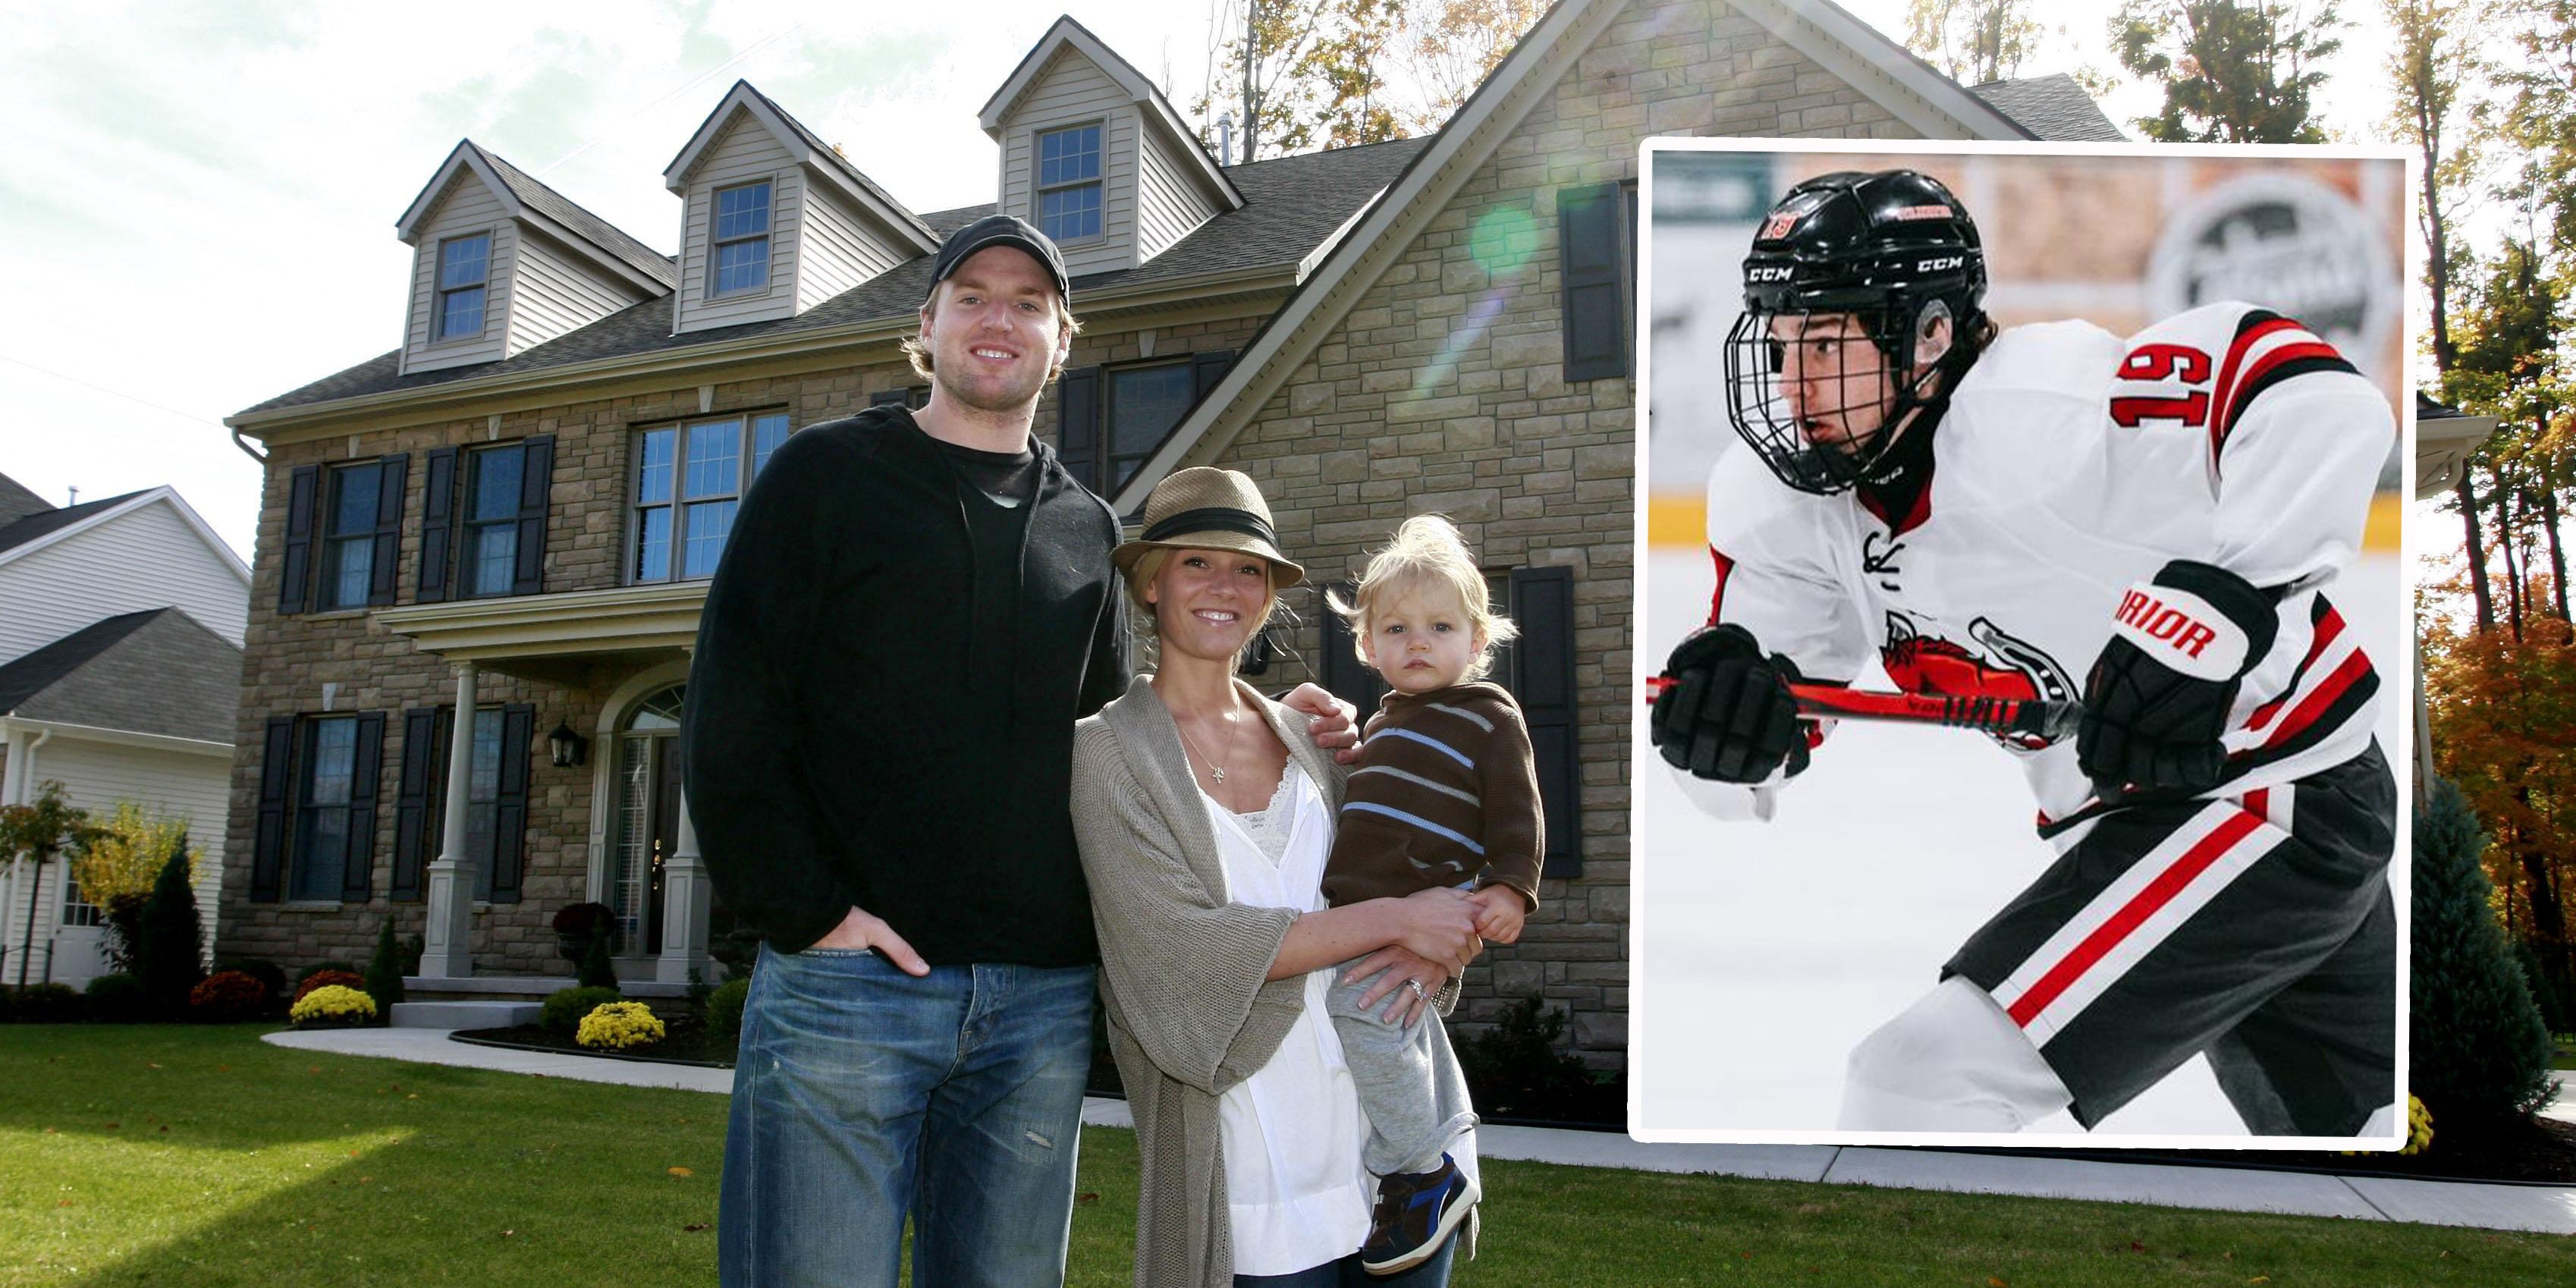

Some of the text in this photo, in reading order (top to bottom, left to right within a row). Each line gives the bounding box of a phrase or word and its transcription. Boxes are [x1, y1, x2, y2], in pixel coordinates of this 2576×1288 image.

[1918, 256, 1963, 272] CCM
[1749, 267, 1793, 281] CCM
[2109, 344, 2212, 427] 19
